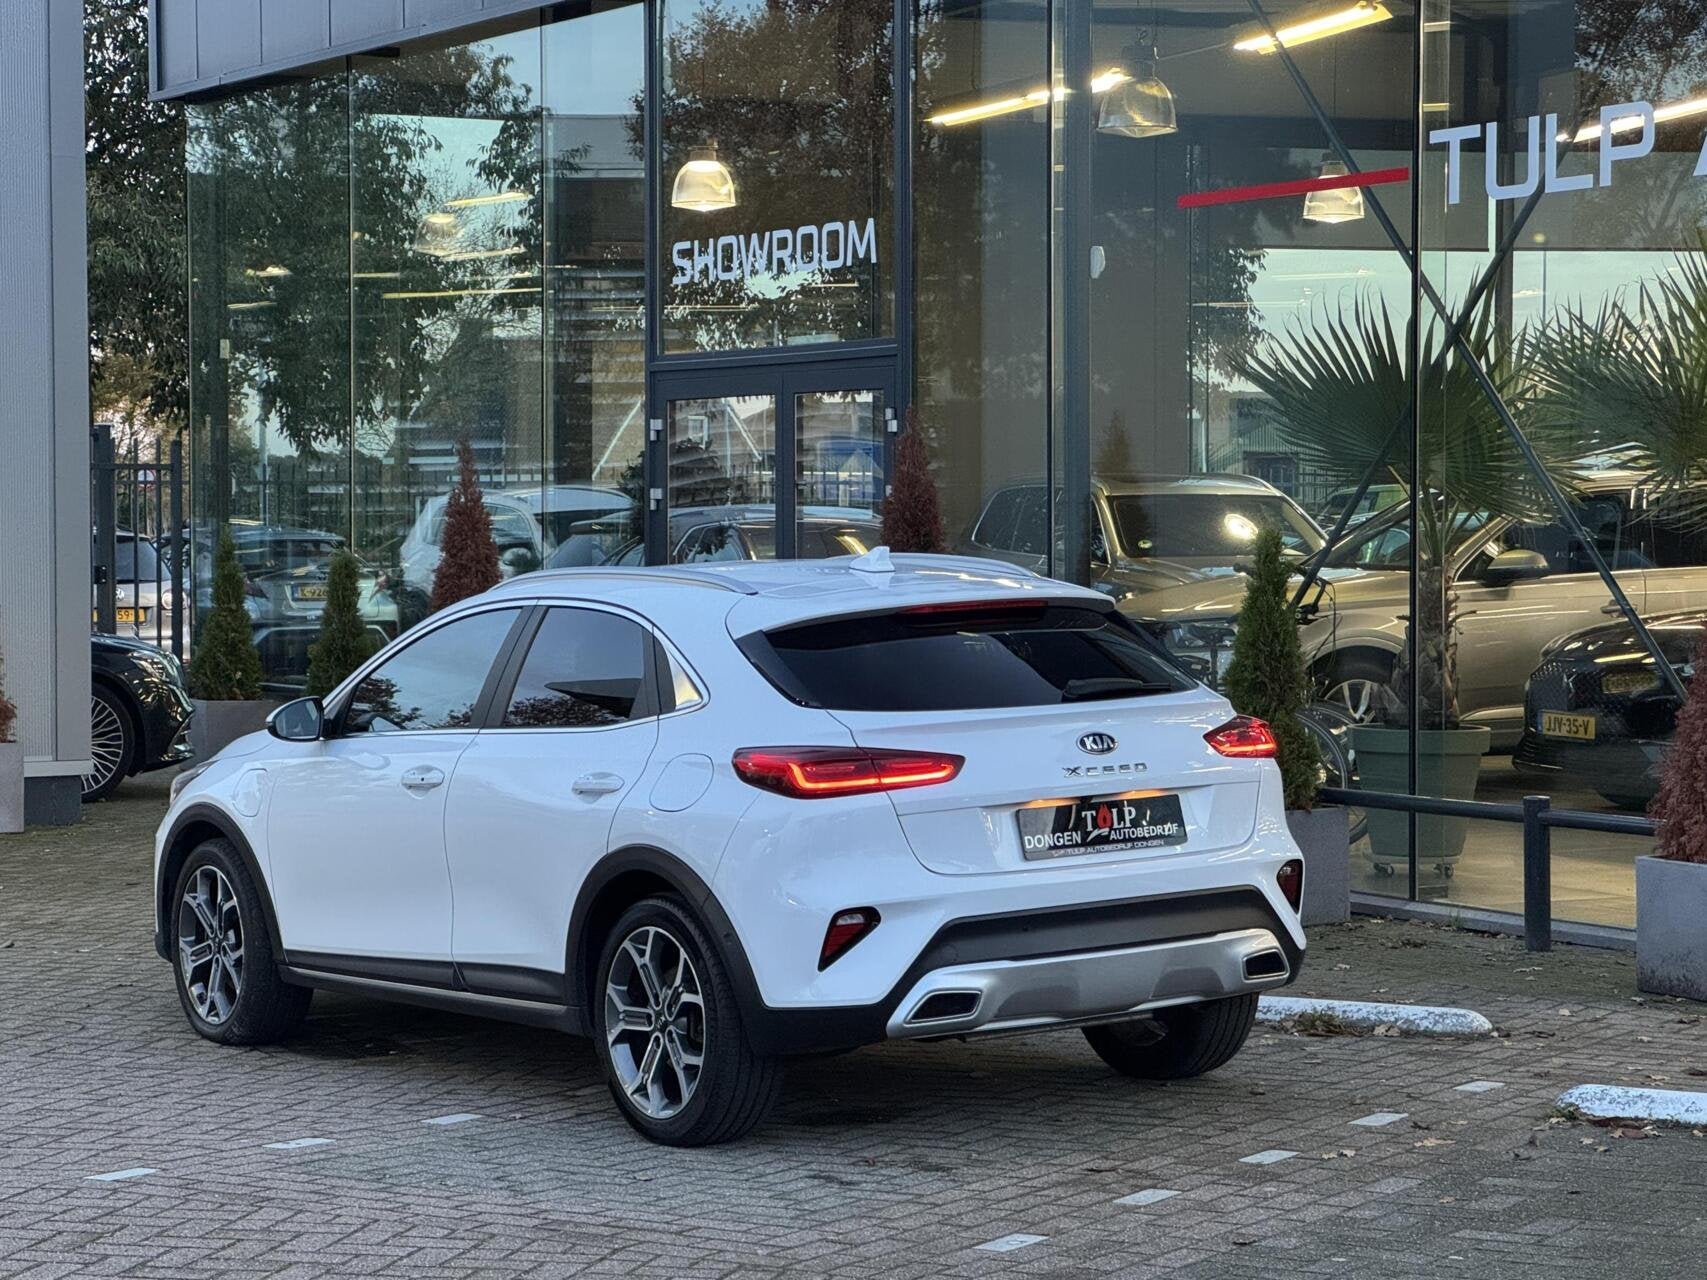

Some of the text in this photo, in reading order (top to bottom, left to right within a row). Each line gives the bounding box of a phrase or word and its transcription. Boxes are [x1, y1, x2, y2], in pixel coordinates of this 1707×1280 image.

[1429, 101, 1655, 204] TULP
[672, 217, 877, 286] SHOWROOM
[1083, 735, 1116, 751] KIA
[1024, 830, 1081, 849] DONGEN
